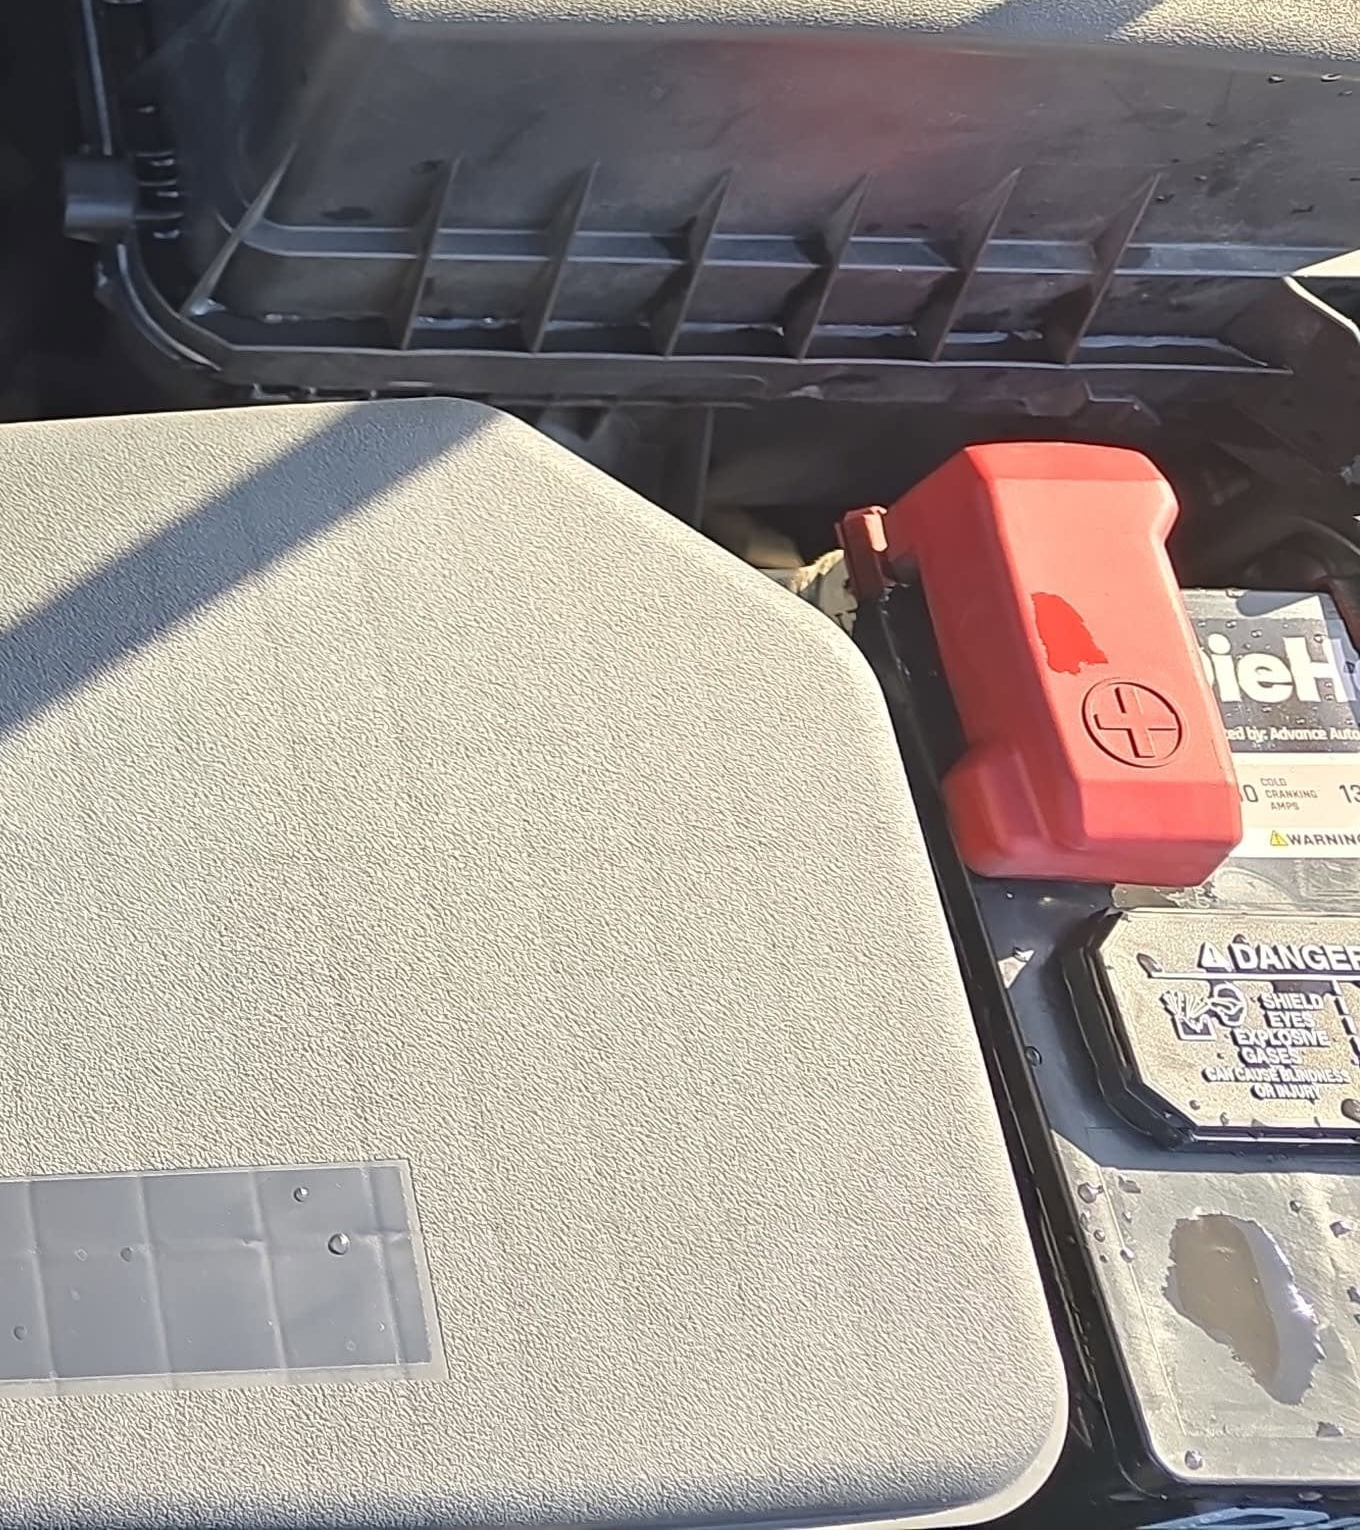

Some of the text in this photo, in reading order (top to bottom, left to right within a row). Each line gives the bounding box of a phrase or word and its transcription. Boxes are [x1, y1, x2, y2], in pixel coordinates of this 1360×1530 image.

[1199, 632, 1360, 703] ieH
[1270, 727, 1328, 741] Advance
[1260, 777, 1287, 787] COLD
[1265, 789, 1318, 799] CRANKING
[1271, 801, 1300, 811] AMPS
[1260, 992, 1324, 1010] SHIELD
[1266, 1011, 1316, 1028] EYES
[1233, 1028, 1330, 1047] EXPLOSIVE
[1240, 1046, 1303, 1065] GASES
